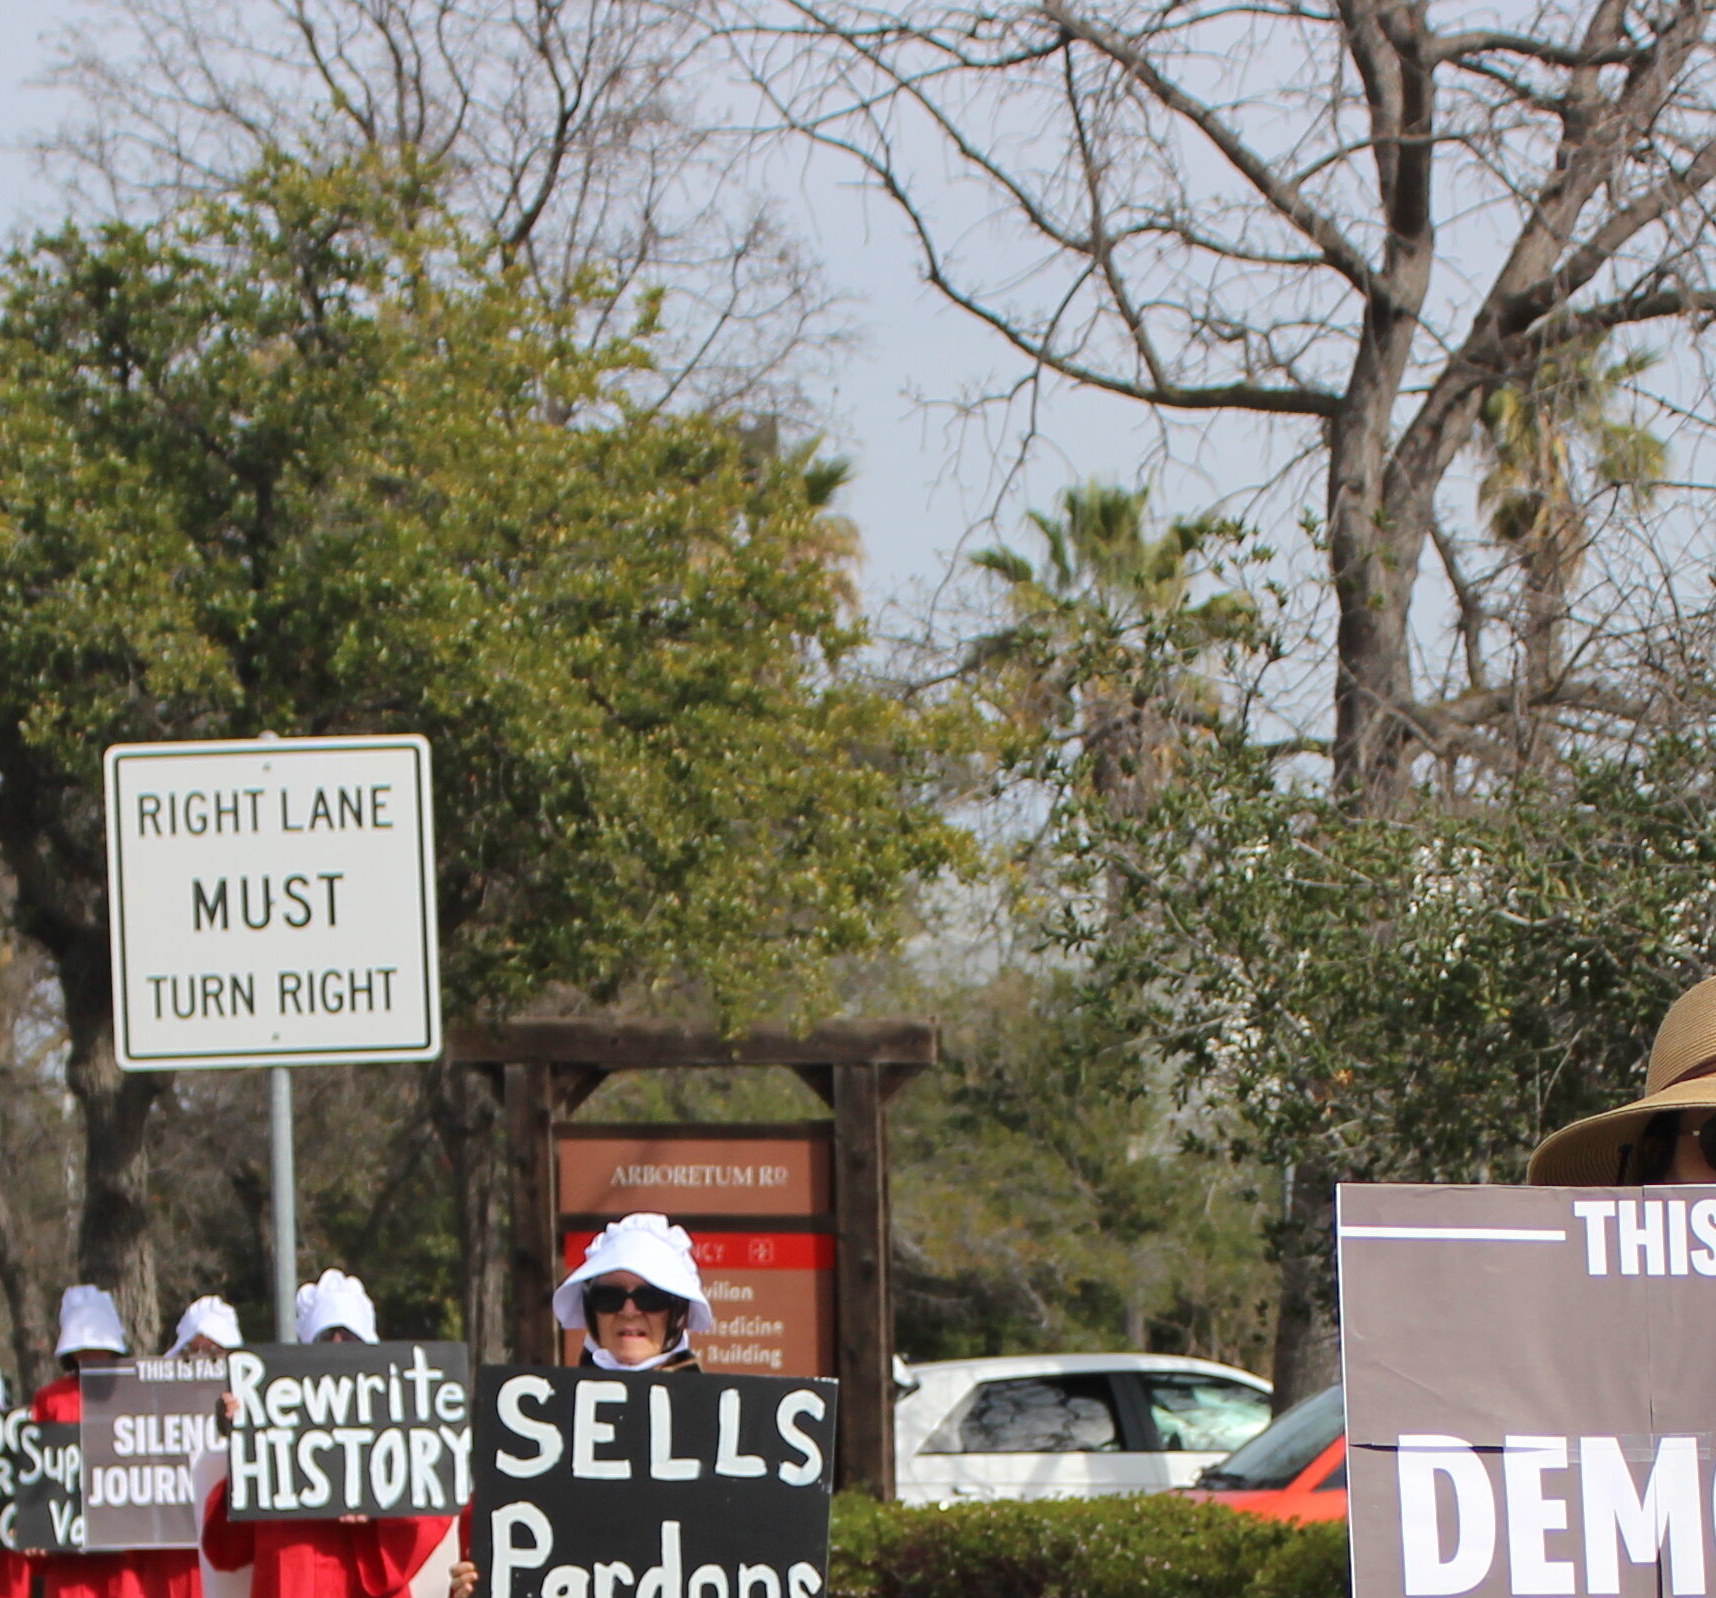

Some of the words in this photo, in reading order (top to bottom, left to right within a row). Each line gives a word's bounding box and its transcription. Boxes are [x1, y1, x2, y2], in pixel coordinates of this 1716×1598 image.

[138, 788, 265, 838] RIGHT
[280, 784, 394, 832] LANE
[192, 872, 344, 931] MUST
[146, 972, 256, 1019] TURN
[277, 966, 397, 1015] RIGHT
[611, 1164, 753, 1187] ARBORETUM
[703, 1281, 755, 1301] vilion
[700, 1316, 785, 1337] edicine
[136, 1359, 175, 1381] THIS
[177, 1359, 194, 1380] IS
[707, 1344, 783, 1369] Building
[228, 1344, 466, 1428] Rewrite
[495, 1374, 826, 1487] SELLS
[18, 1424, 83, 1495] Sup
[231, 1425, 473, 1511] HISTORY
